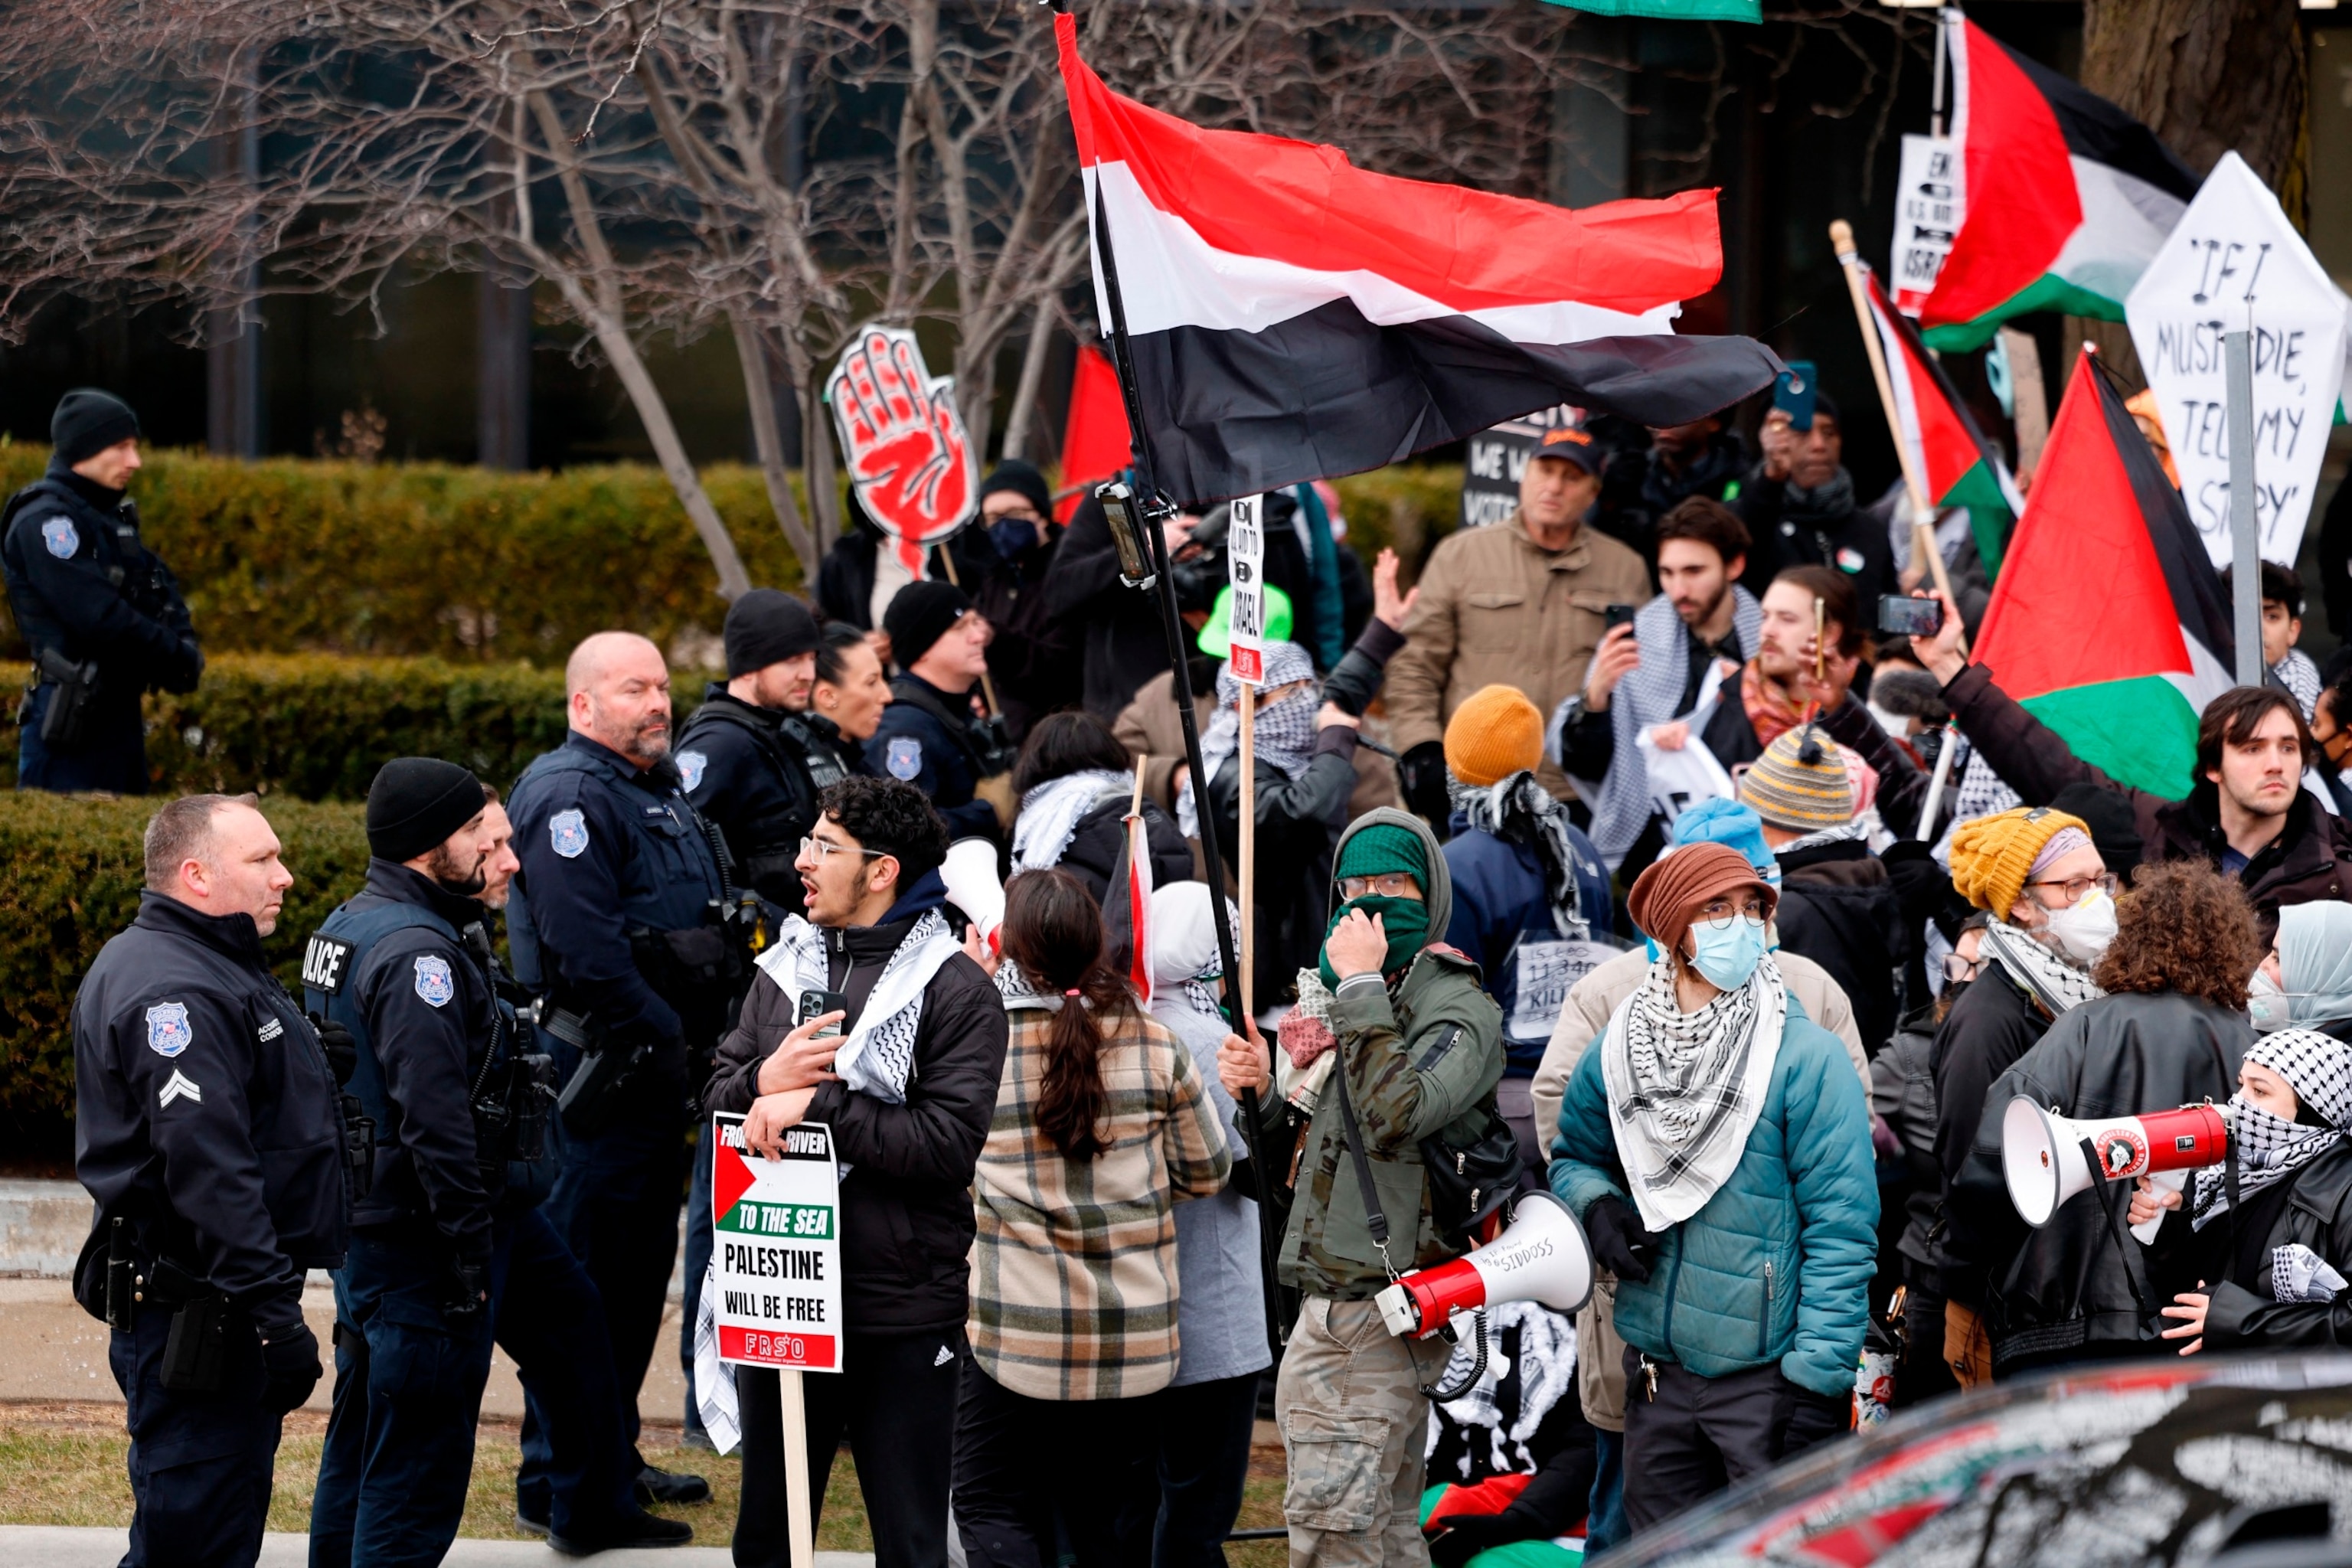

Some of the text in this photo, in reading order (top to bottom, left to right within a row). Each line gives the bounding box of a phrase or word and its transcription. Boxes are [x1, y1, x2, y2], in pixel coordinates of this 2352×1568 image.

[2243, 243, 2272, 303] I
[2154, 321, 2224, 377] MUST
[2181, 400, 2305, 462] TEL MY
[1471, 440, 1505, 480] WE
[1250, 530, 1258, 556] TO
[302, 937, 346, 988] OLICE
[720, 1124, 826, 1155] FRO RIVER
[740, 1204, 828, 1236] TO THE SEA
[725, 1243, 824, 1281] PALESTINE
[725, 1290, 825, 1323] WILL BE FREE
[746, 1333, 805, 1359] FRSO
